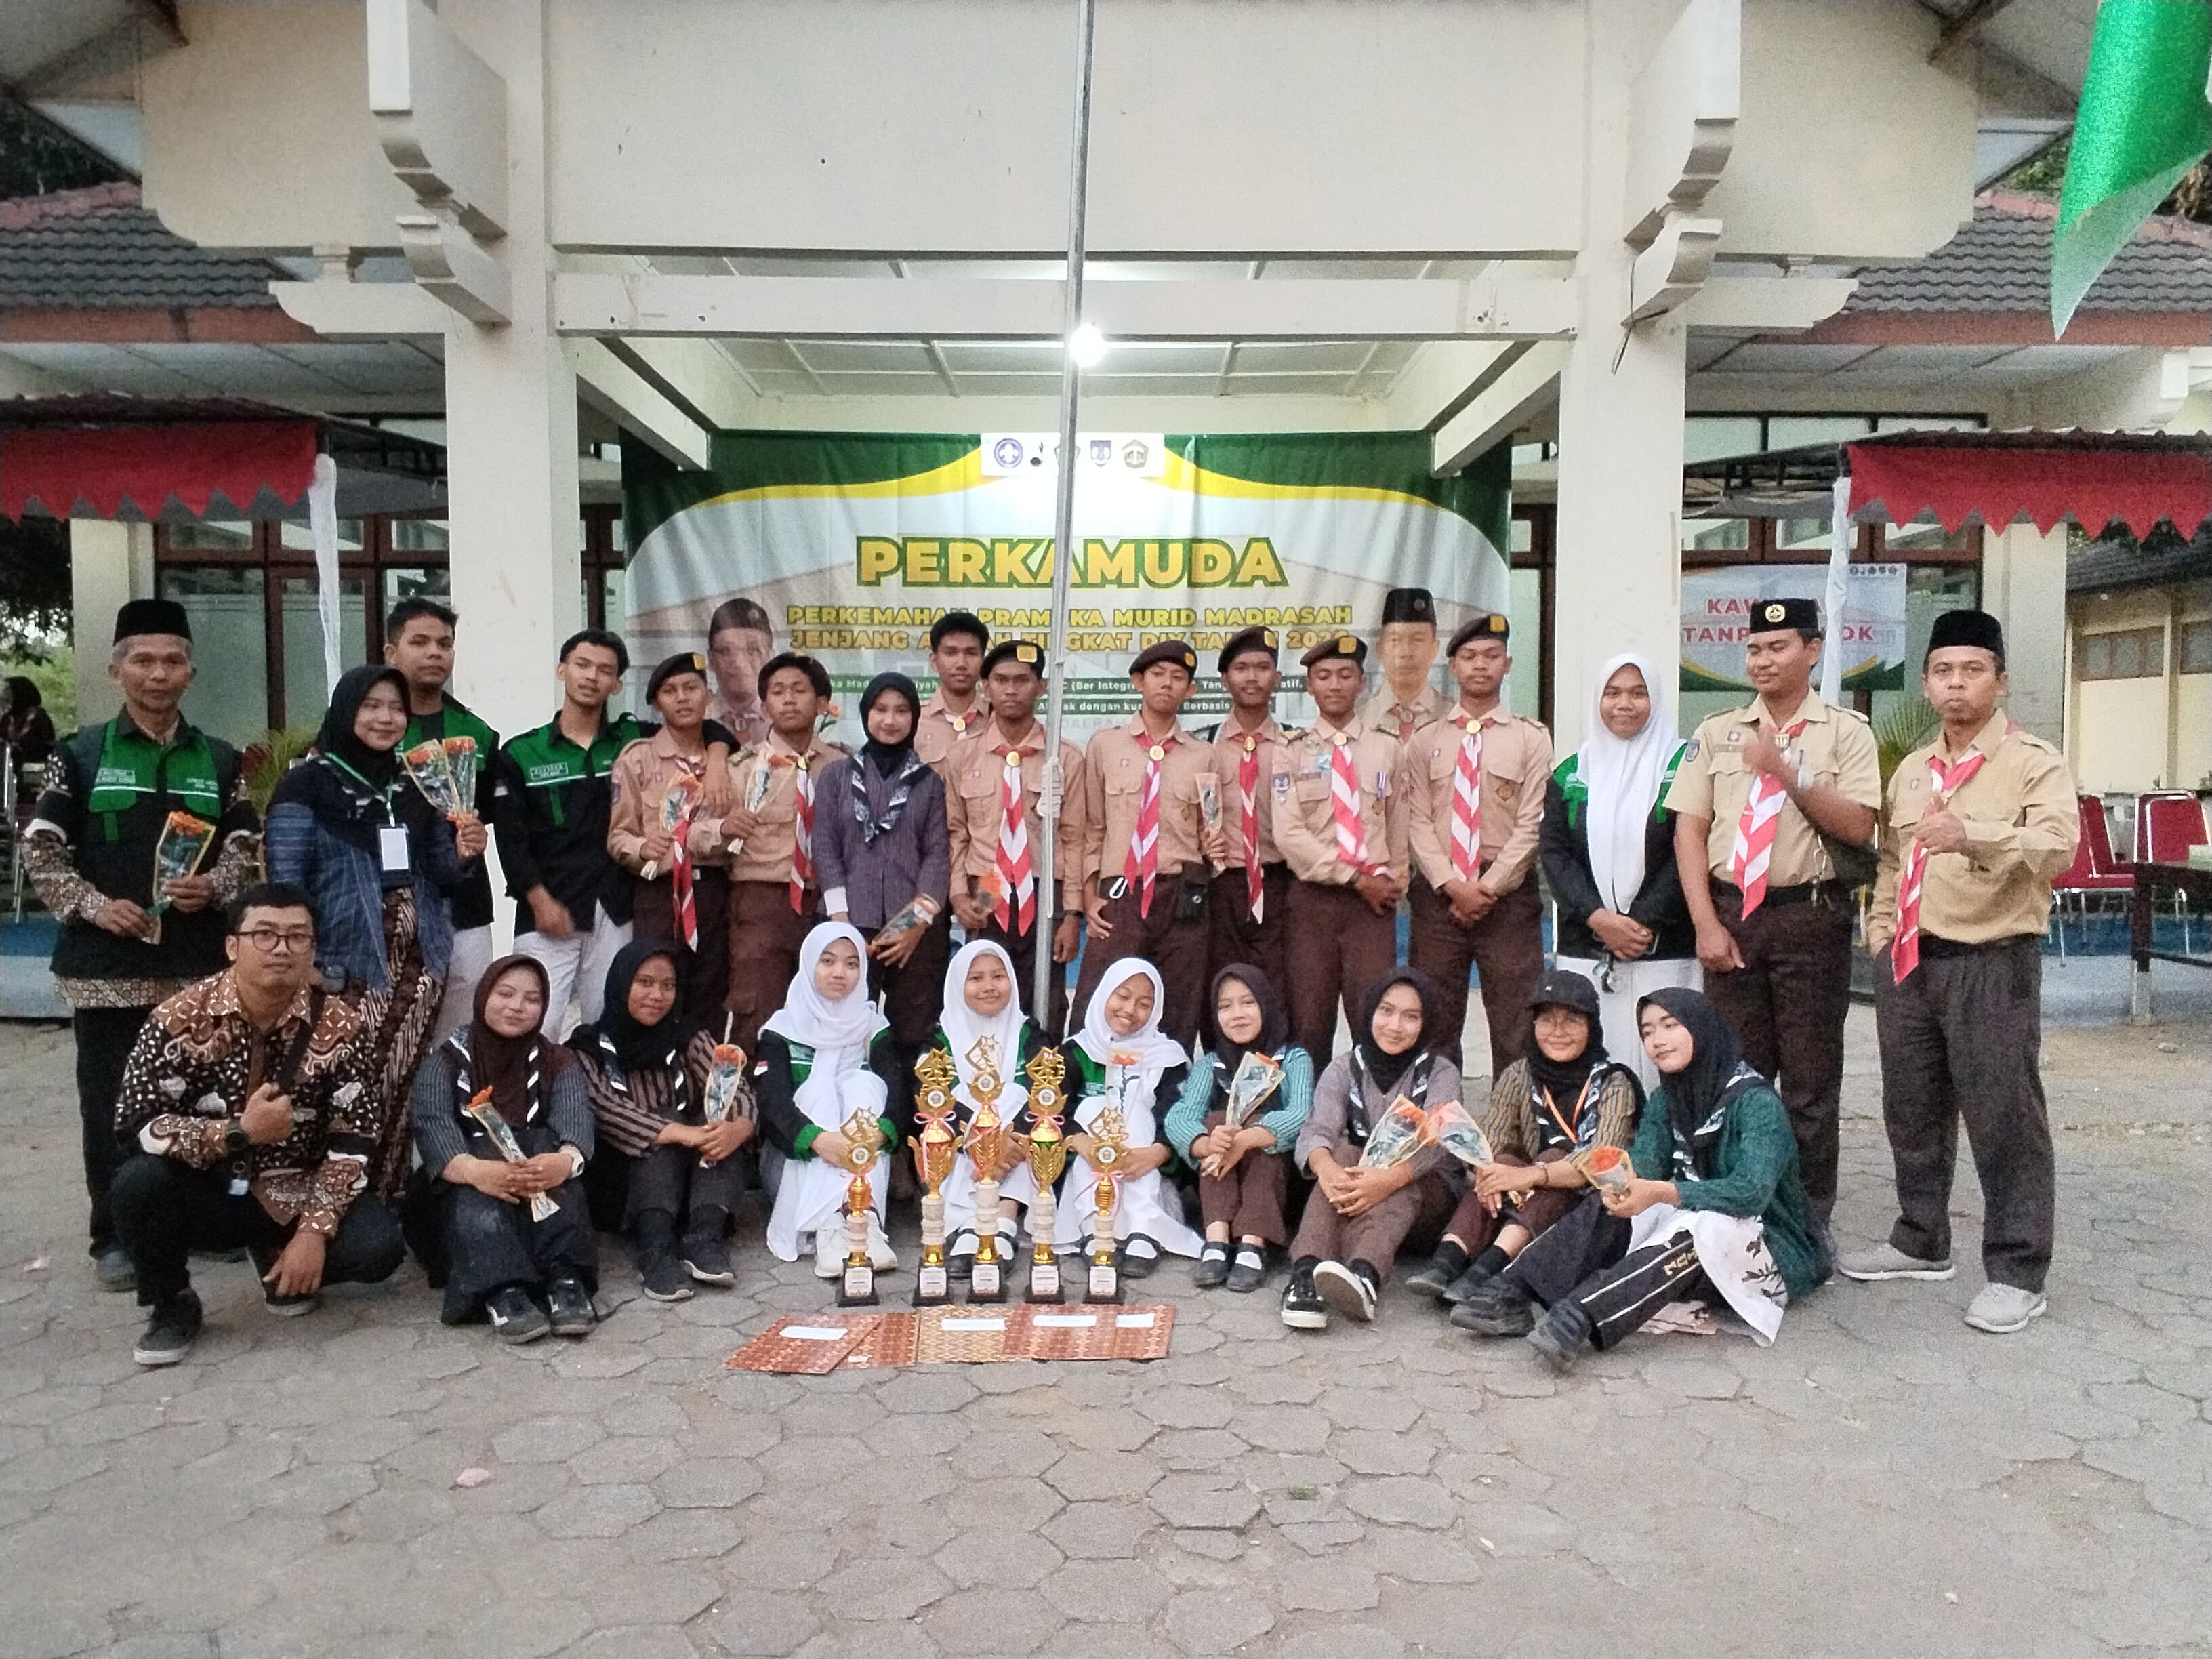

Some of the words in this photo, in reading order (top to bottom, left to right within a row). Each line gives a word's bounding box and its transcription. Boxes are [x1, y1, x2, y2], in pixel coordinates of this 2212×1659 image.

[856, 536, 1290, 588] PERKAMUDA
[787, 606, 970, 625] PERKEMAHA
[977, 608, 1105, 627] PRAMKA
[1113, 608, 1197, 627] MURID
[1204, 606, 1352, 626] MADRASAH
[790, 630, 909, 649] JENJANG
[1021, 632, 1133, 651] TIGKAT
[1286, 629, 1349, 649] 202
[1682, 627, 1750, 642] TANP
